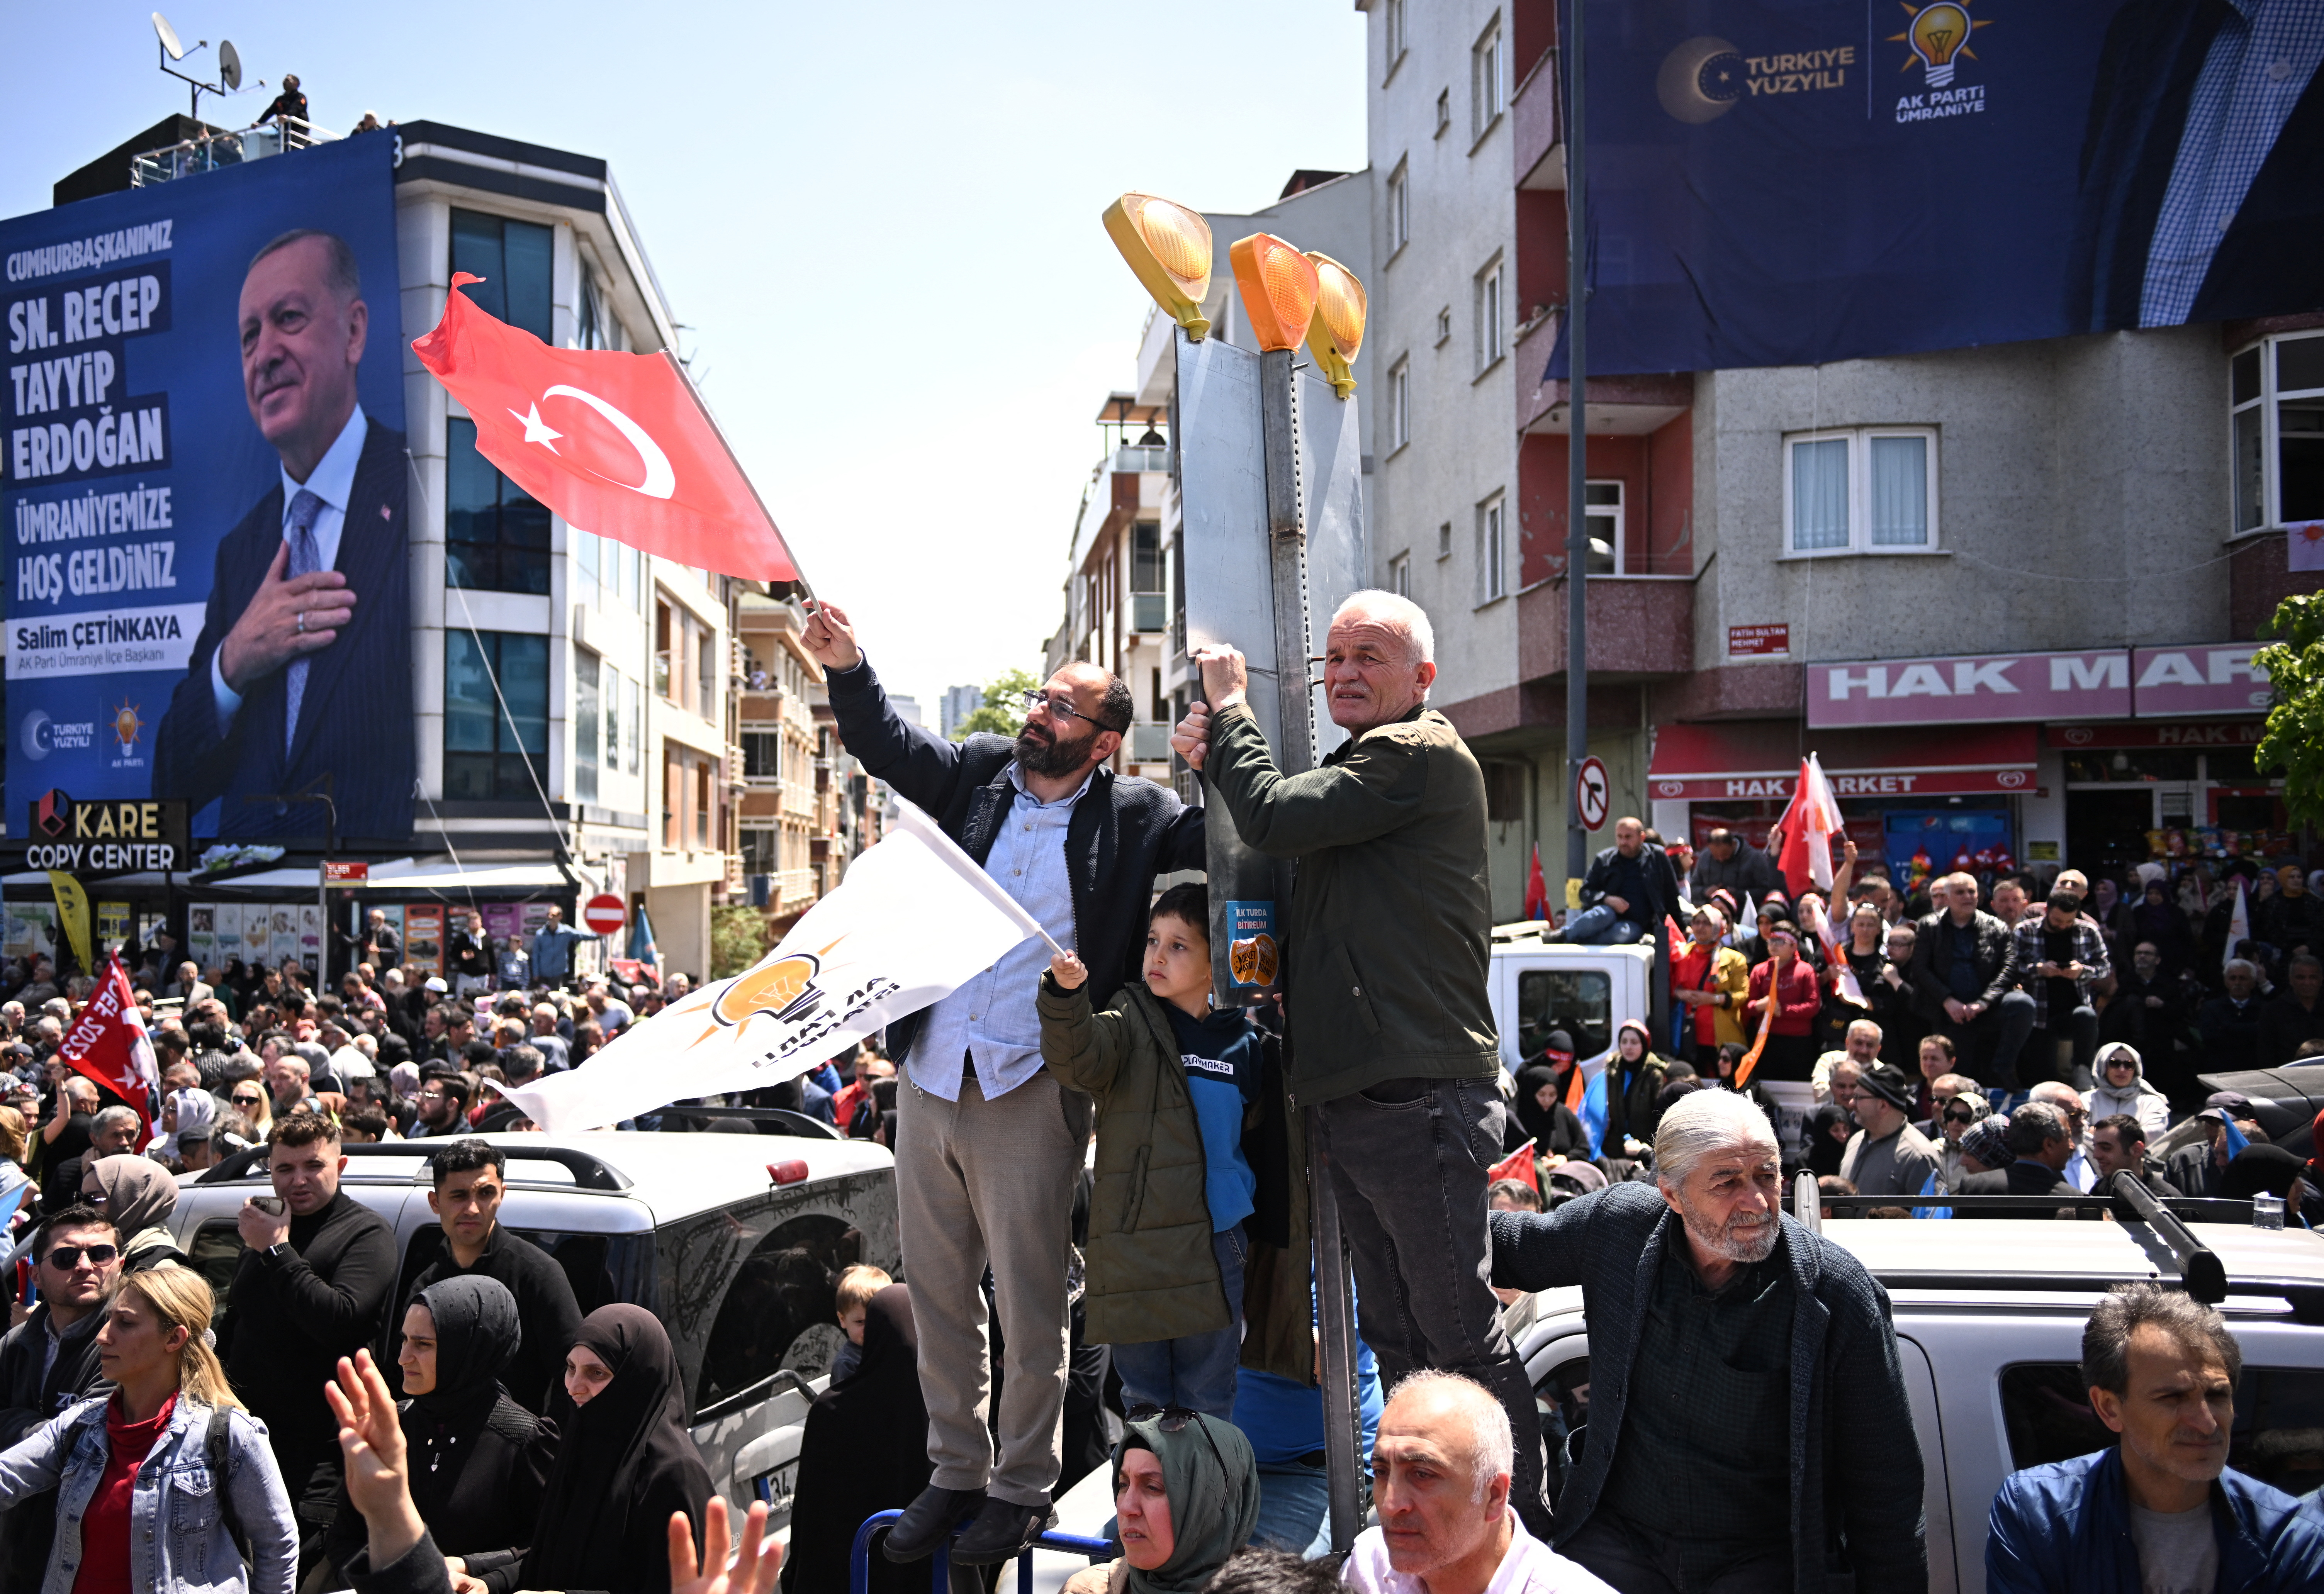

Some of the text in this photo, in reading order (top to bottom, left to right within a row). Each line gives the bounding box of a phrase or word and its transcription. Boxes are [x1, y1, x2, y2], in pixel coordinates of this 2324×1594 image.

[1896, 85, 1985, 110] AK PARTİ
[1896, 99, 1985, 124] ÜMRANİYE
[7, 219, 173, 282] CUMHURBAŞKANIMIZ
[9, 275, 160, 354] SN. RECEP
[11, 350, 115, 416] TAYYİP
[13, 405, 164, 481] ERDOĞAN
[15, 482, 172, 546] ÜMRANİYEMİZE
[18, 541, 177, 605] HOŞ GELDİNİZ
[17, 614, 182, 651] Salim ÇETİNKAYA
[1731, 638, 1764, 648] MEHMET
[1755, 627, 1786, 637] SULTAN
[19, 648, 164, 670] AK Parti Ümraniye İlçe Başkanı
[1829, 660, 2020, 700] HAK
[2158, 725, 2229, 744] HAK
[1726, 778, 1786, 797] HAK
[76, 803, 159, 839] KARE
[27, 844, 175, 870] COPY CENTER
[1236, 907, 1267, 917] İLK TURDA
[1238, 919, 1266, 929] BİTİRELİM
[1260, 953, 1276, 970] DEVLET
[1183, 1056, 1230, 1073] PLAYMAKER
[770, 1471, 791, 1506] 34
